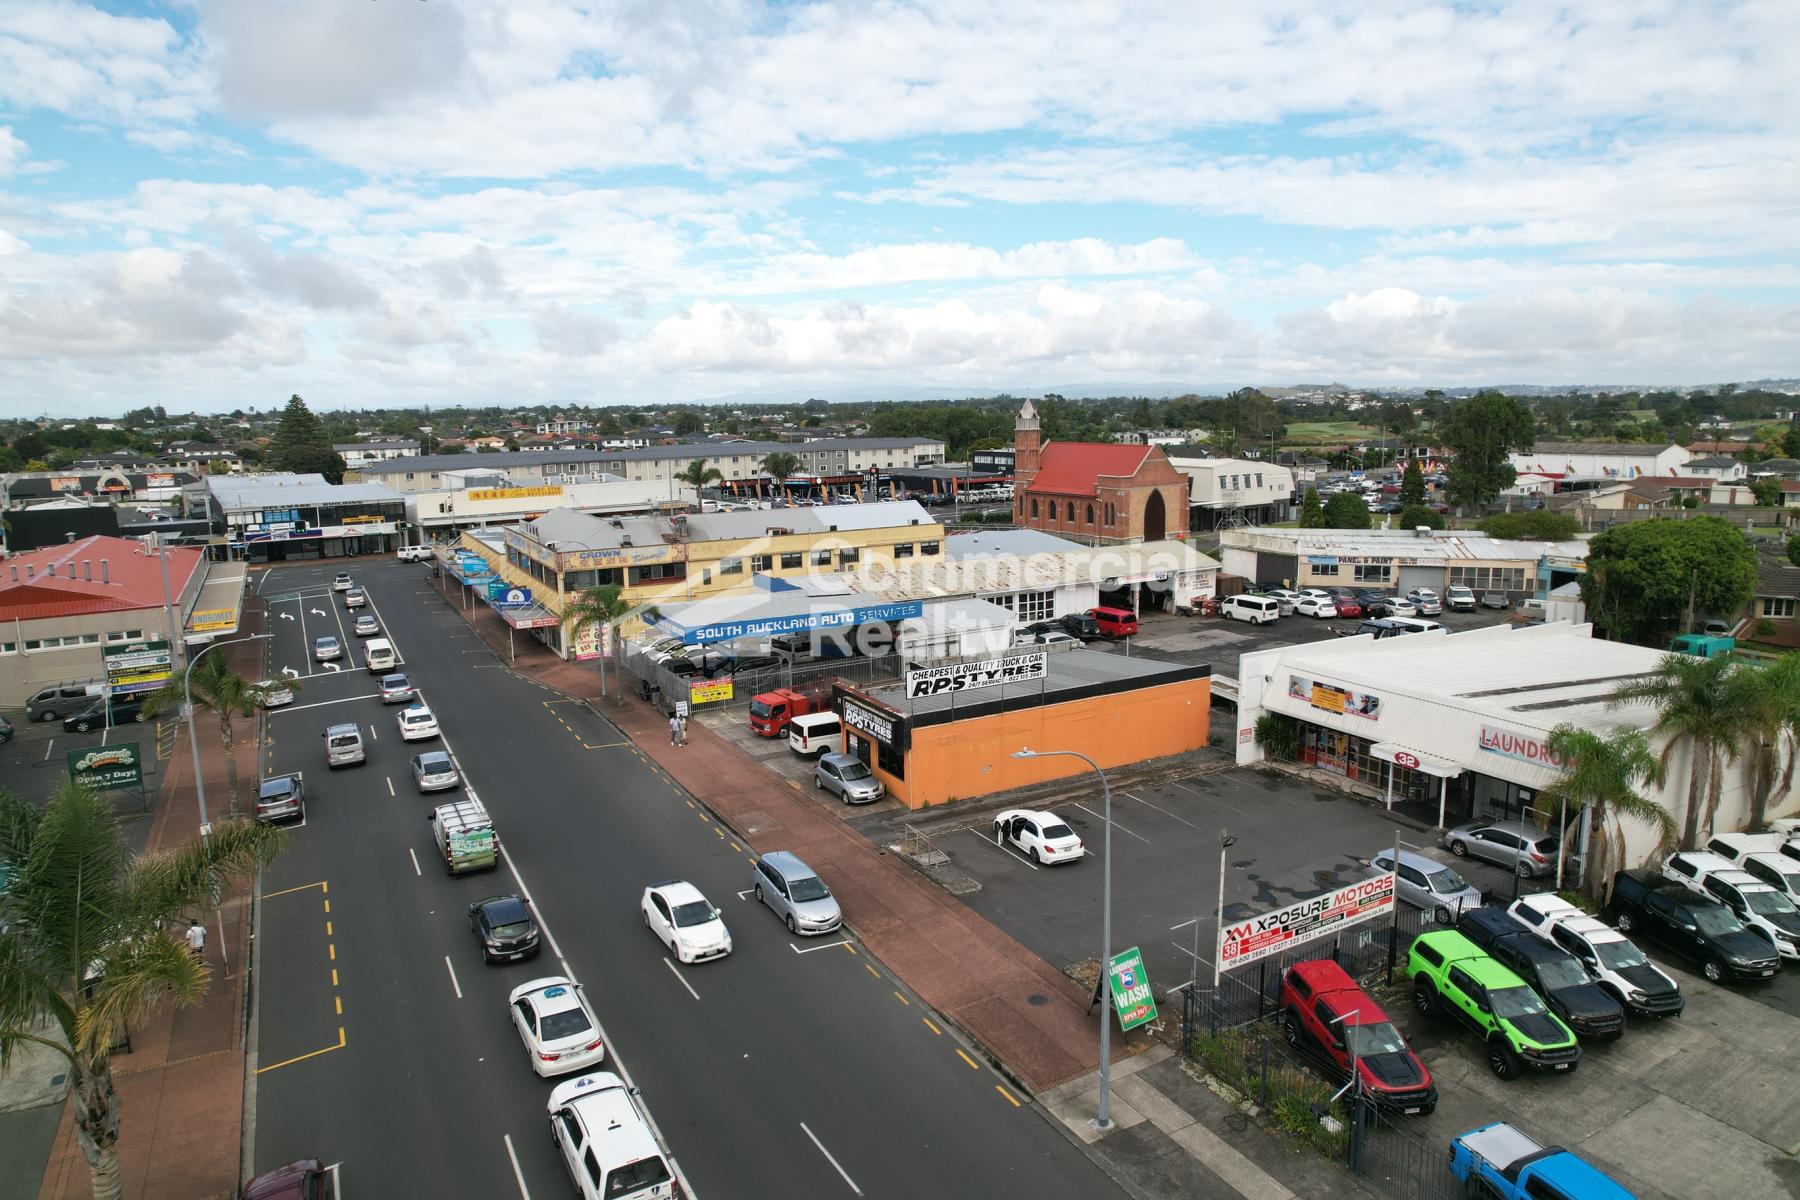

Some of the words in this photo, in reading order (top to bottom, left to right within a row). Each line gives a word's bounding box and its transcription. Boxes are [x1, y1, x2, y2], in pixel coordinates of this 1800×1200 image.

[579, 549, 621, 558] CROWN
[1371, 557, 1393, 565] PAINT
[696, 622, 742, 640] SOUTH
[746, 617, 816, 634] AUCKLAND
[821, 612, 855, 626] AUTO
[859, 605, 916, 620] SERVICES
[912, 667, 952, 680] CHEAPEST
[962, 662, 995, 674] QUALITY
[996, 659, 1020, 669] TRUCK
[1029, 653, 1042, 663] CAR
[1400, 753, 1415, 768] 32
[113, 769, 137, 779] Days
[1256, 897, 1330, 933] XPOSURE
[1332, 875, 1393, 907] MOTORS
[1223, 943, 1238, 957] 38
[1116, 983, 1150, 1009] WASH
